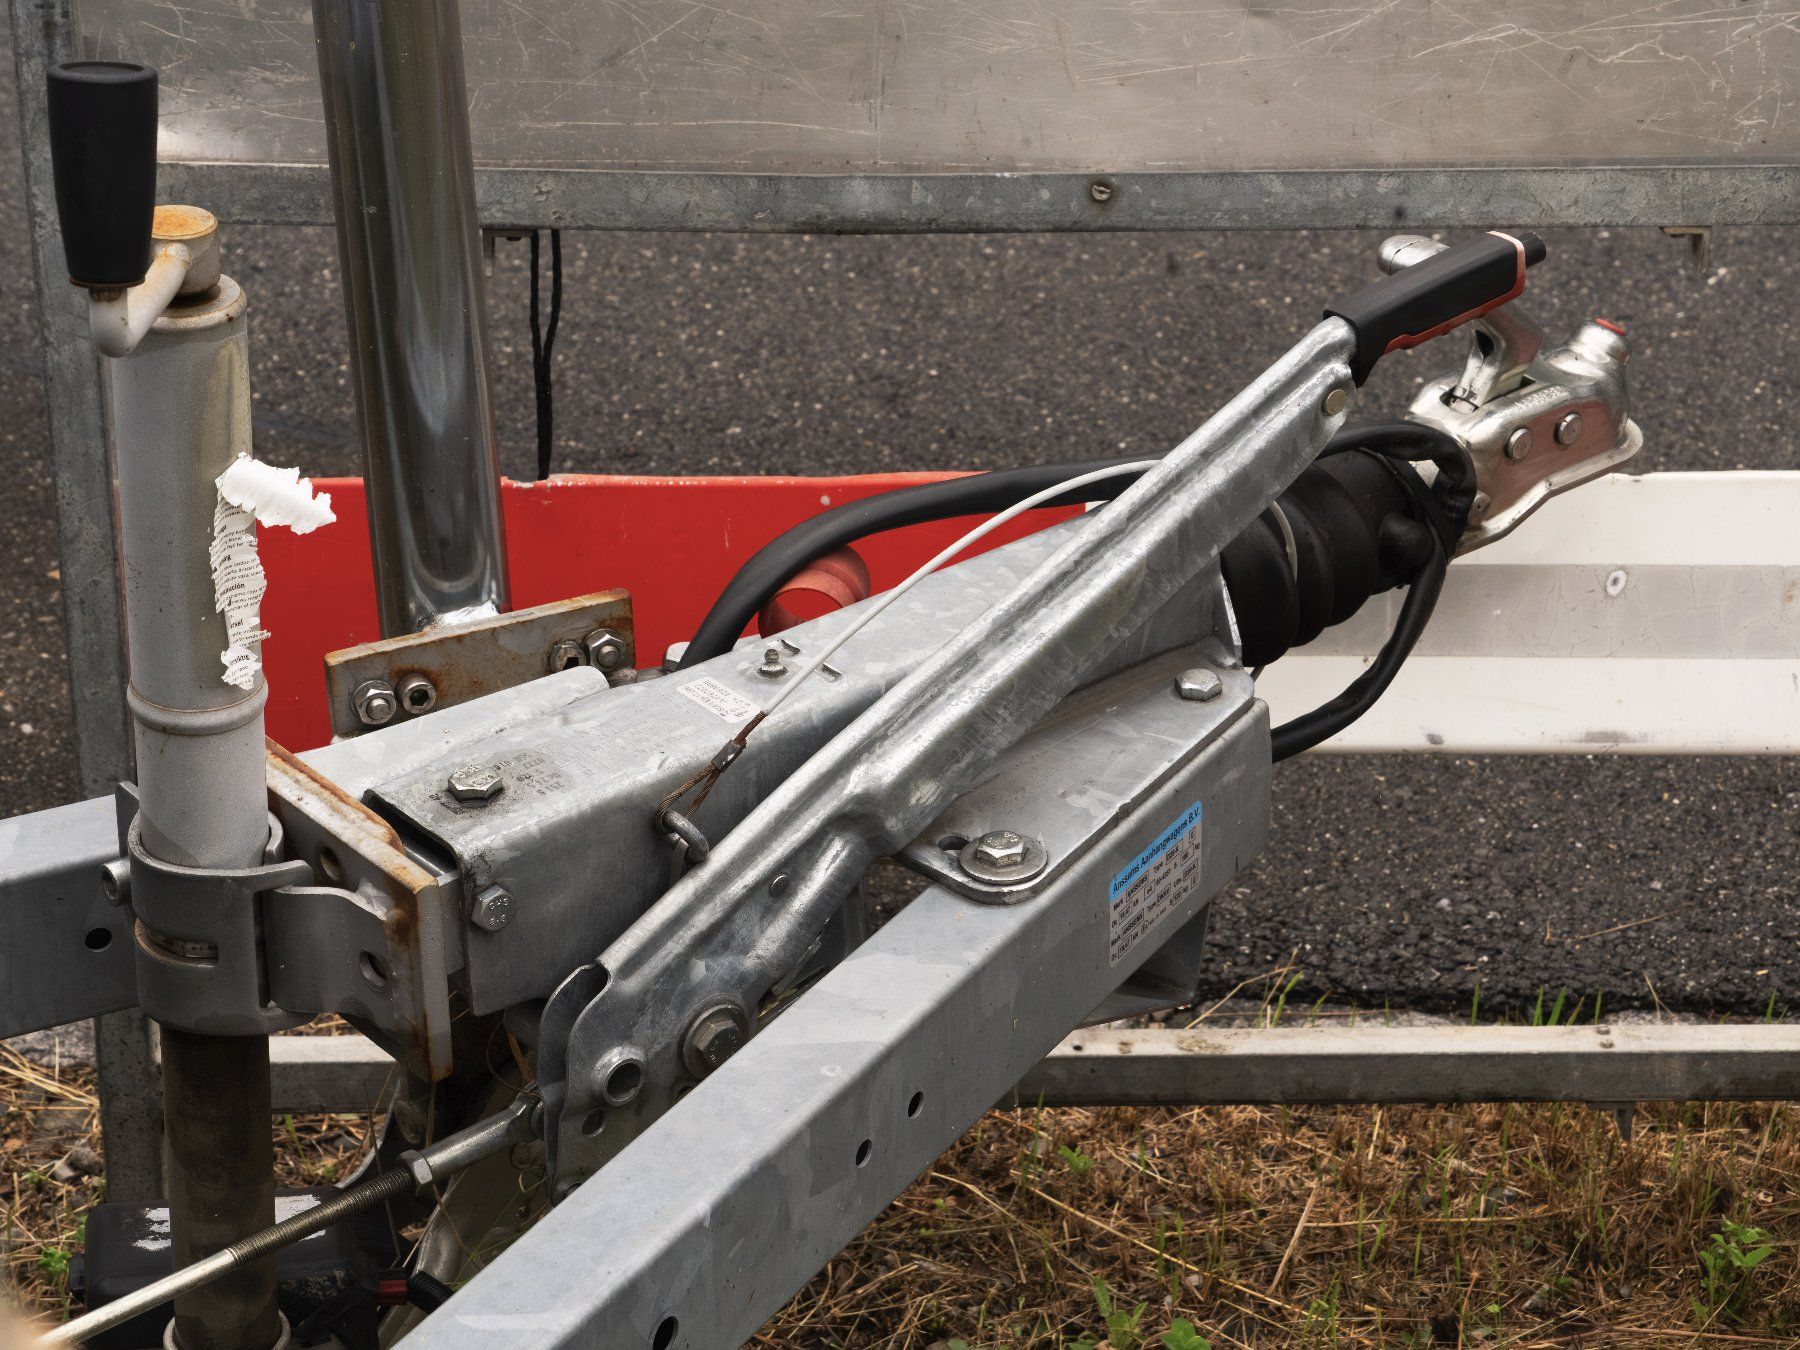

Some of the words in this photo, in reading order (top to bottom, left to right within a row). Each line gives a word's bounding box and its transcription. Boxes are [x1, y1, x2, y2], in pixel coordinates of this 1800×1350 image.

[1113, 867, 1140, 893] Anssems
[1140, 820, 1188, 868] Aanhangwagens
[1127, 874, 1149, 897] ANSSEMS
[1123, 912, 1144, 934] ANSSEMS
